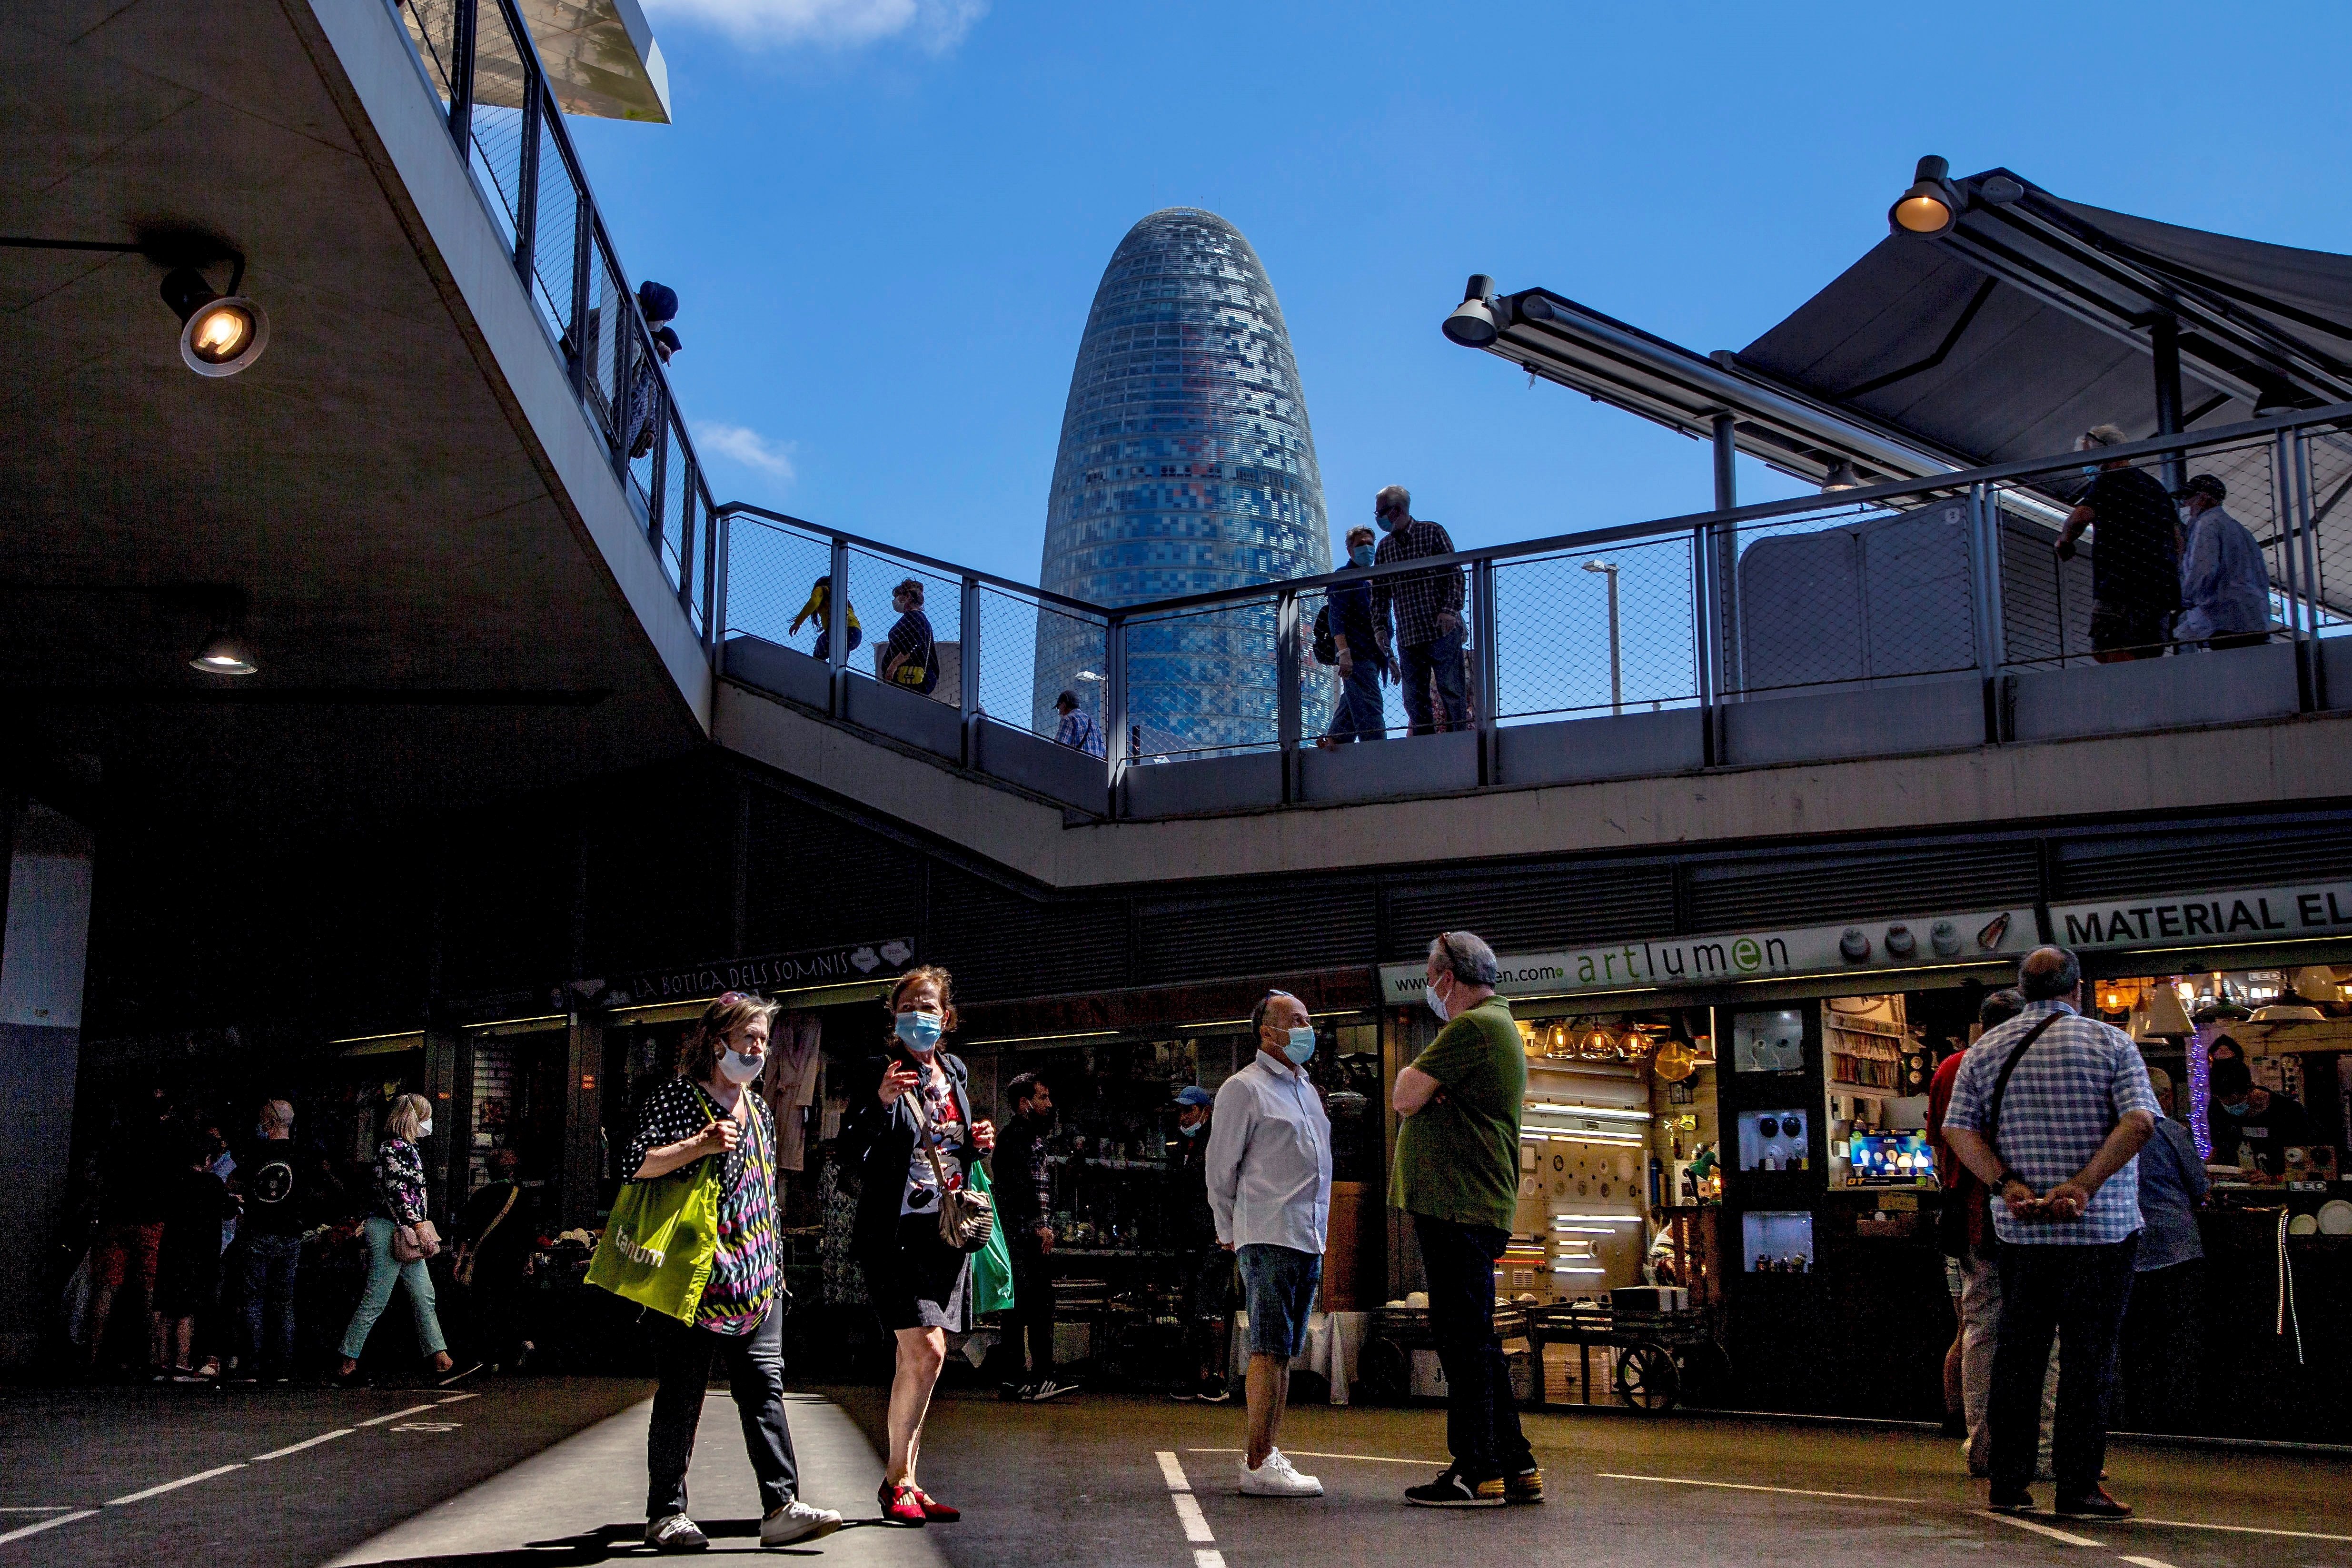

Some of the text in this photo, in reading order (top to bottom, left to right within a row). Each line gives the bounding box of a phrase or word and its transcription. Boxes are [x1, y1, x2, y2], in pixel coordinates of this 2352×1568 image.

[2064, 898, 2285, 944] MATERIAL
[634, 951, 848, 998] LA BOTIGA DELS SOMNIS
[1577, 937, 1789, 982] artlumen
[2248, 971, 2280, 981] LED
[2289, 1181, 2327, 1191] LED
